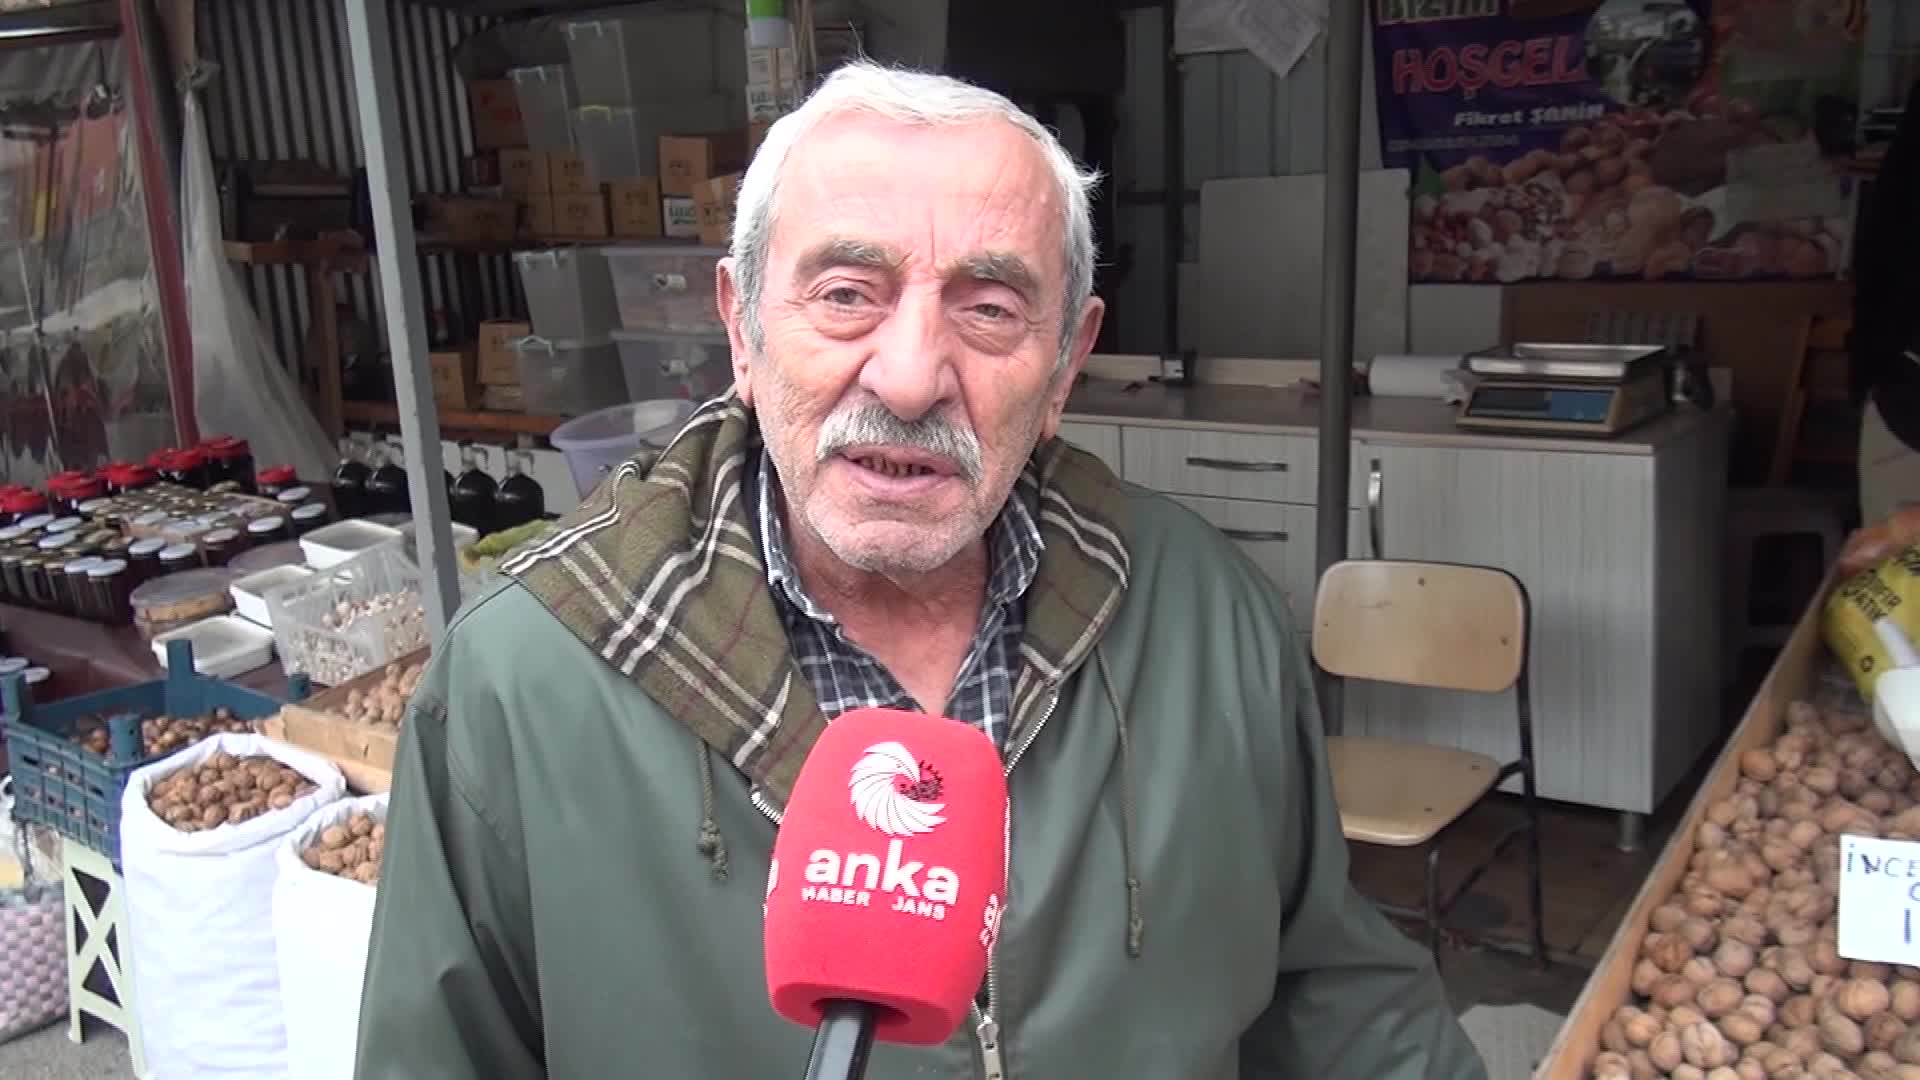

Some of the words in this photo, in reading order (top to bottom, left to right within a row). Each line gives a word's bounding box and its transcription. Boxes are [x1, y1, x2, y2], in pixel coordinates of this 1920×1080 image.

[1454, 112, 1523, 127] Fikret
[804, 839, 960, 906] anka
[802, 886, 870, 907] HABER
[891, 896, 946, 921] JANS
